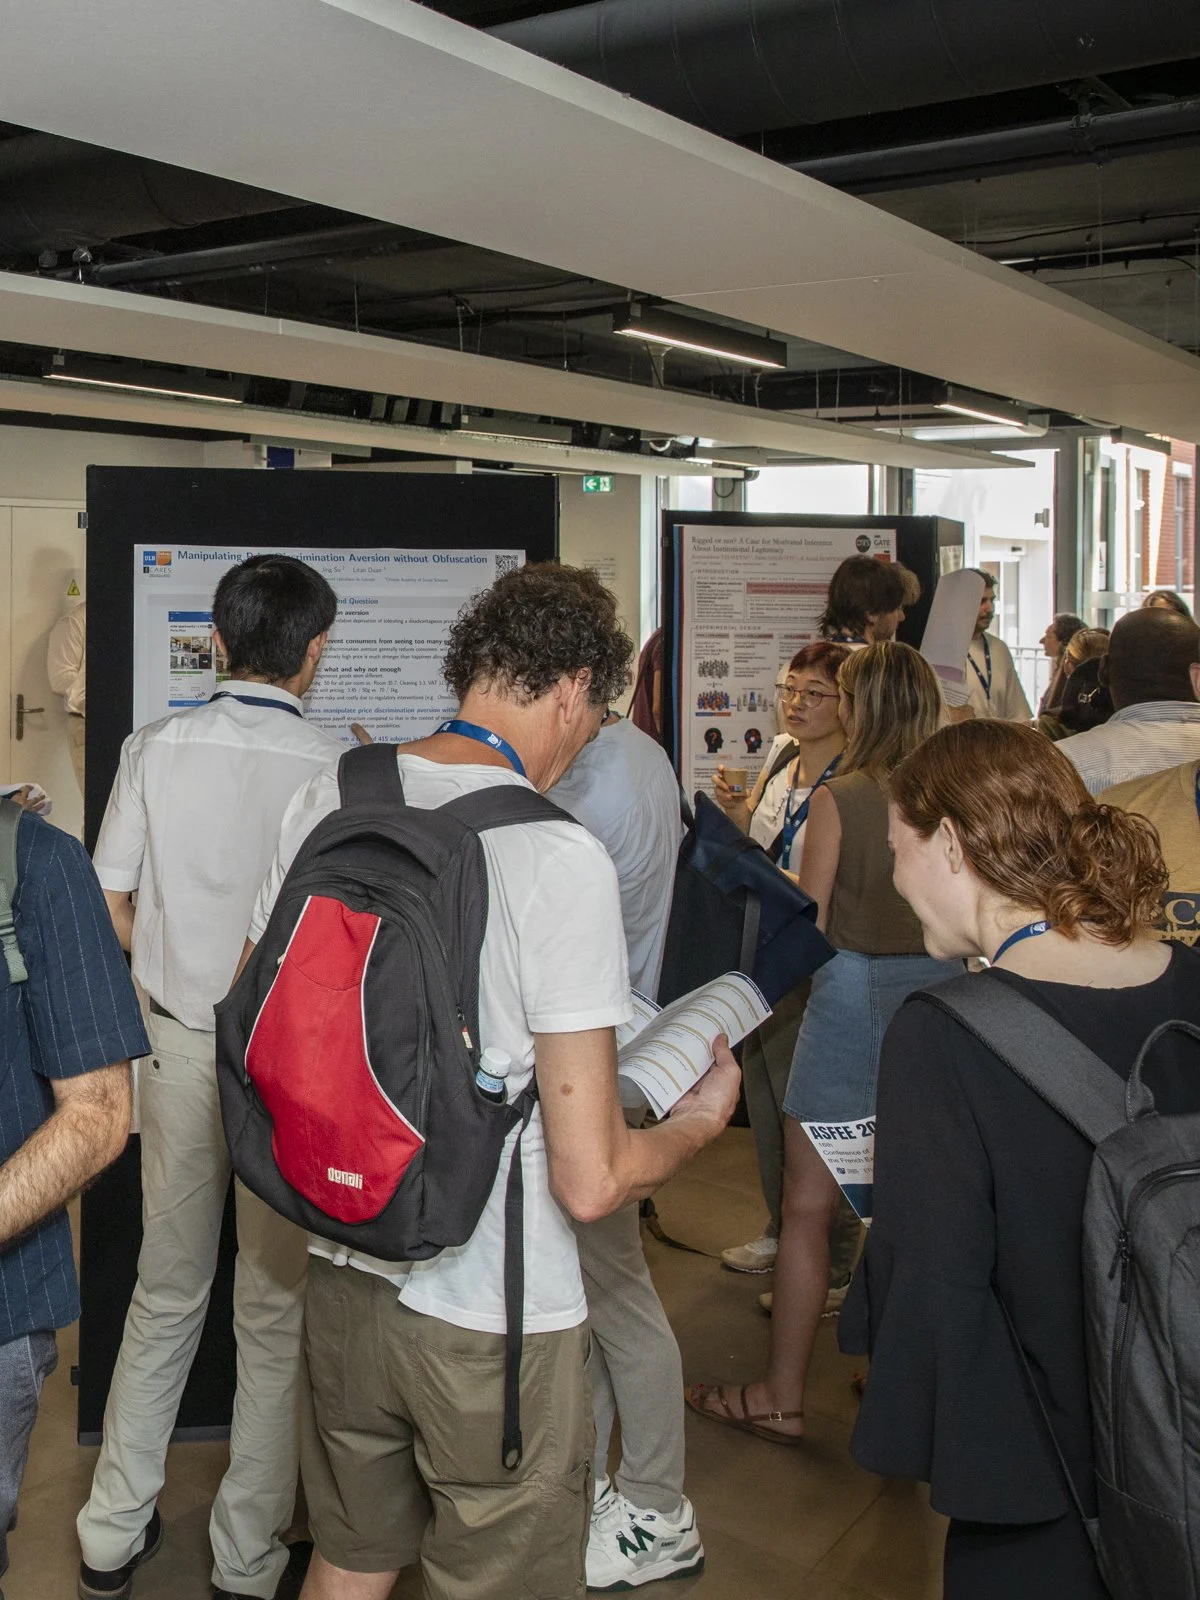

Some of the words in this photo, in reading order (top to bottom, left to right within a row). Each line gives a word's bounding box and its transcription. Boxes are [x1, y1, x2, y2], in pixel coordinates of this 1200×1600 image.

[692, 537, 712, 545] Rigged
[178, 551, 242, 562] Manipulating
[276, 553, 345, 562] rimination
[349, 554, 390, 562] Aversion
[393, 555, 428, 563] without
[433, 555, 487, 563] Obfuscation
[809, 1126, 856, 1140] ASFEE
